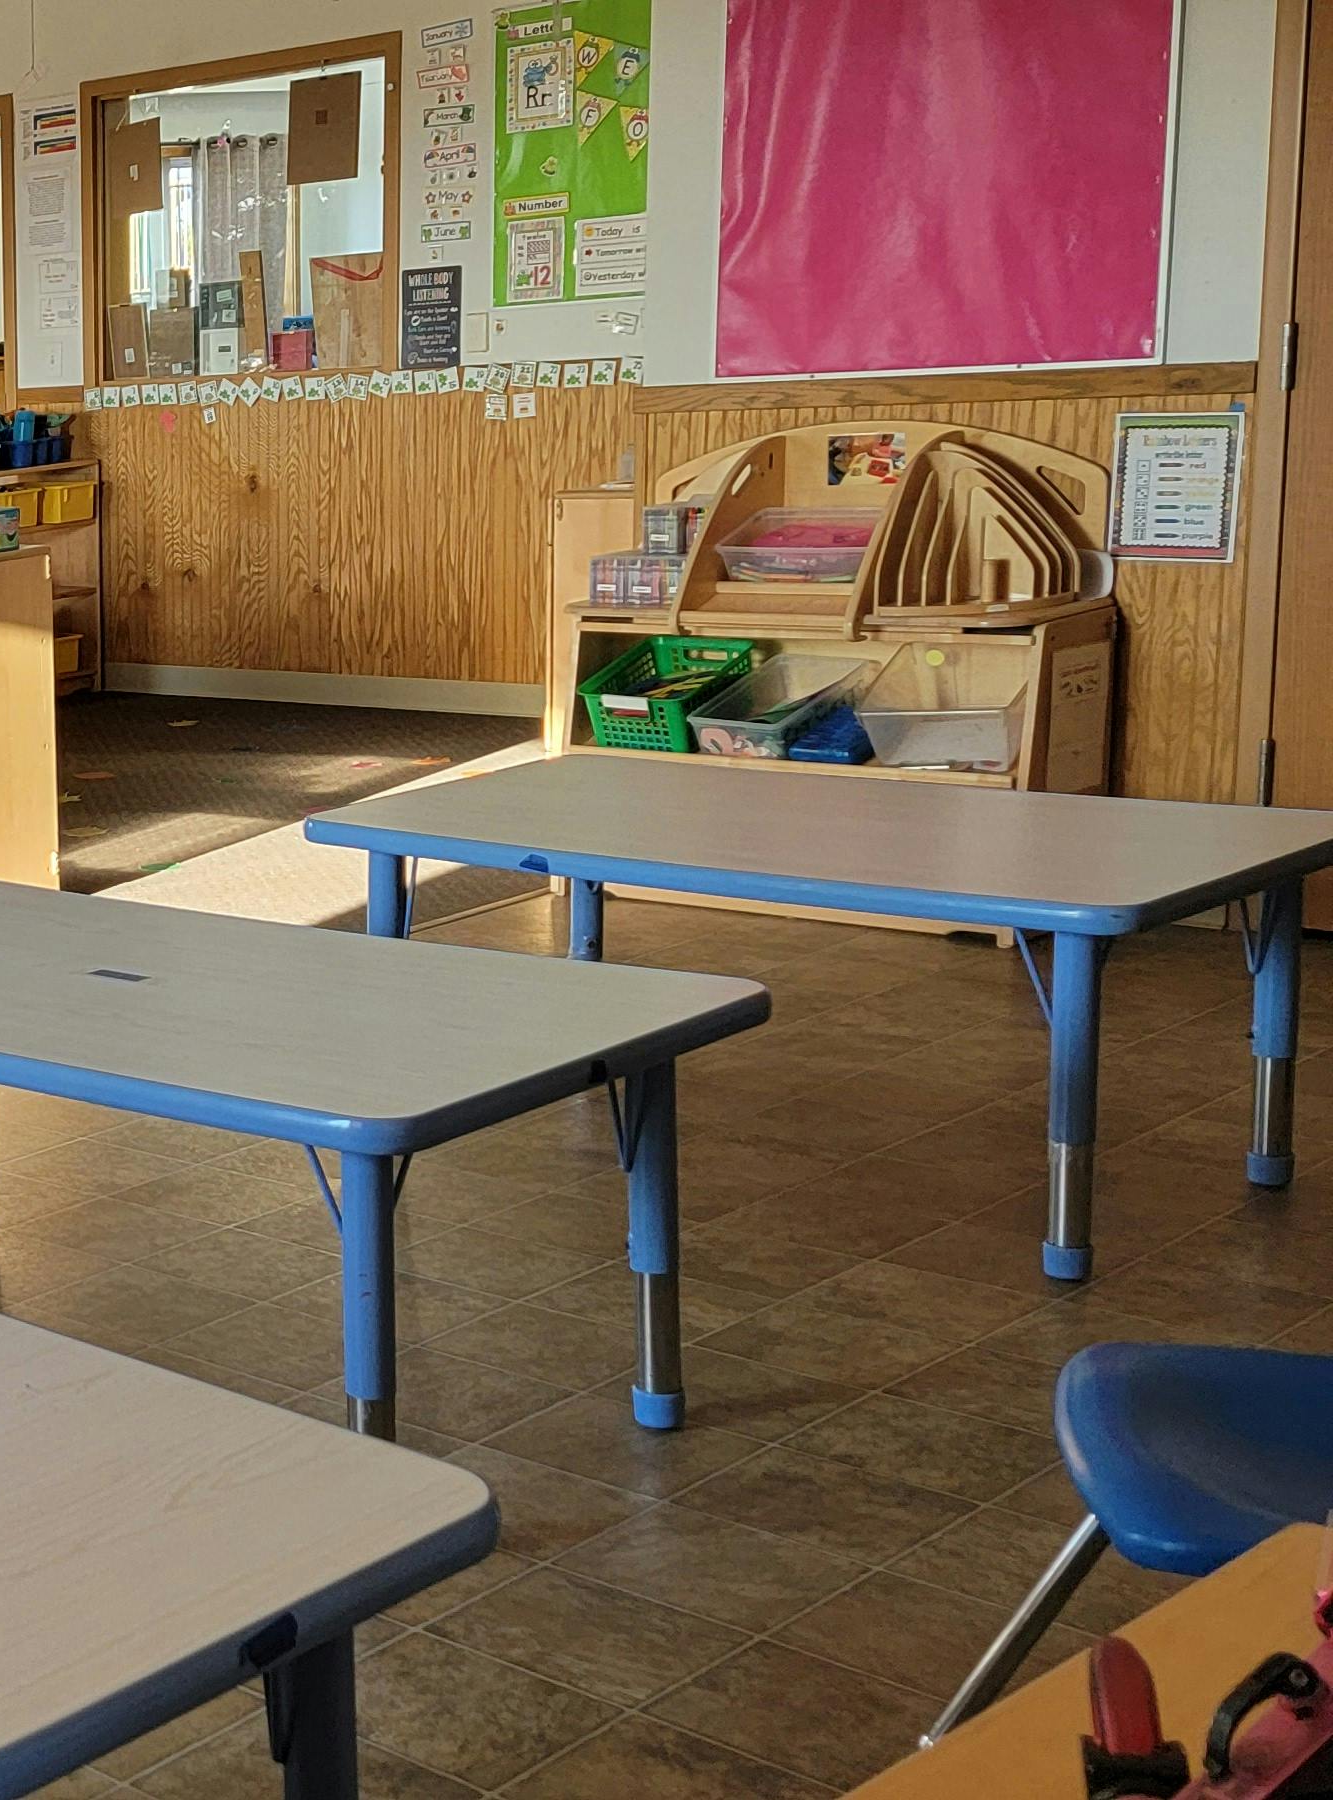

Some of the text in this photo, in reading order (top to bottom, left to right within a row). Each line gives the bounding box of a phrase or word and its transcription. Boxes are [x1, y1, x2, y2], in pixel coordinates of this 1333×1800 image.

[425, 30, 453, 41] January
[581, 48, 597, 65] W
[622, 59, 635, 76] E
[436, 112, 458, 120] March
[585, 108, 597, 124] F
[439, 149, 460, 162] April
[438, 190, 459, 201] May
[518, 199, 563, 212] Number
[434, 226, 456, 237] June
[595, 225, 642, 238] Today is
[595, 247, 634, 257] Tomorrow
[408, 271, 454, 287] WHOLE BODY
[533, 265, 551, 287] 12
[590, 269, 636, 282] Yesterday
[412, 286, 450, 302] LISTENING
